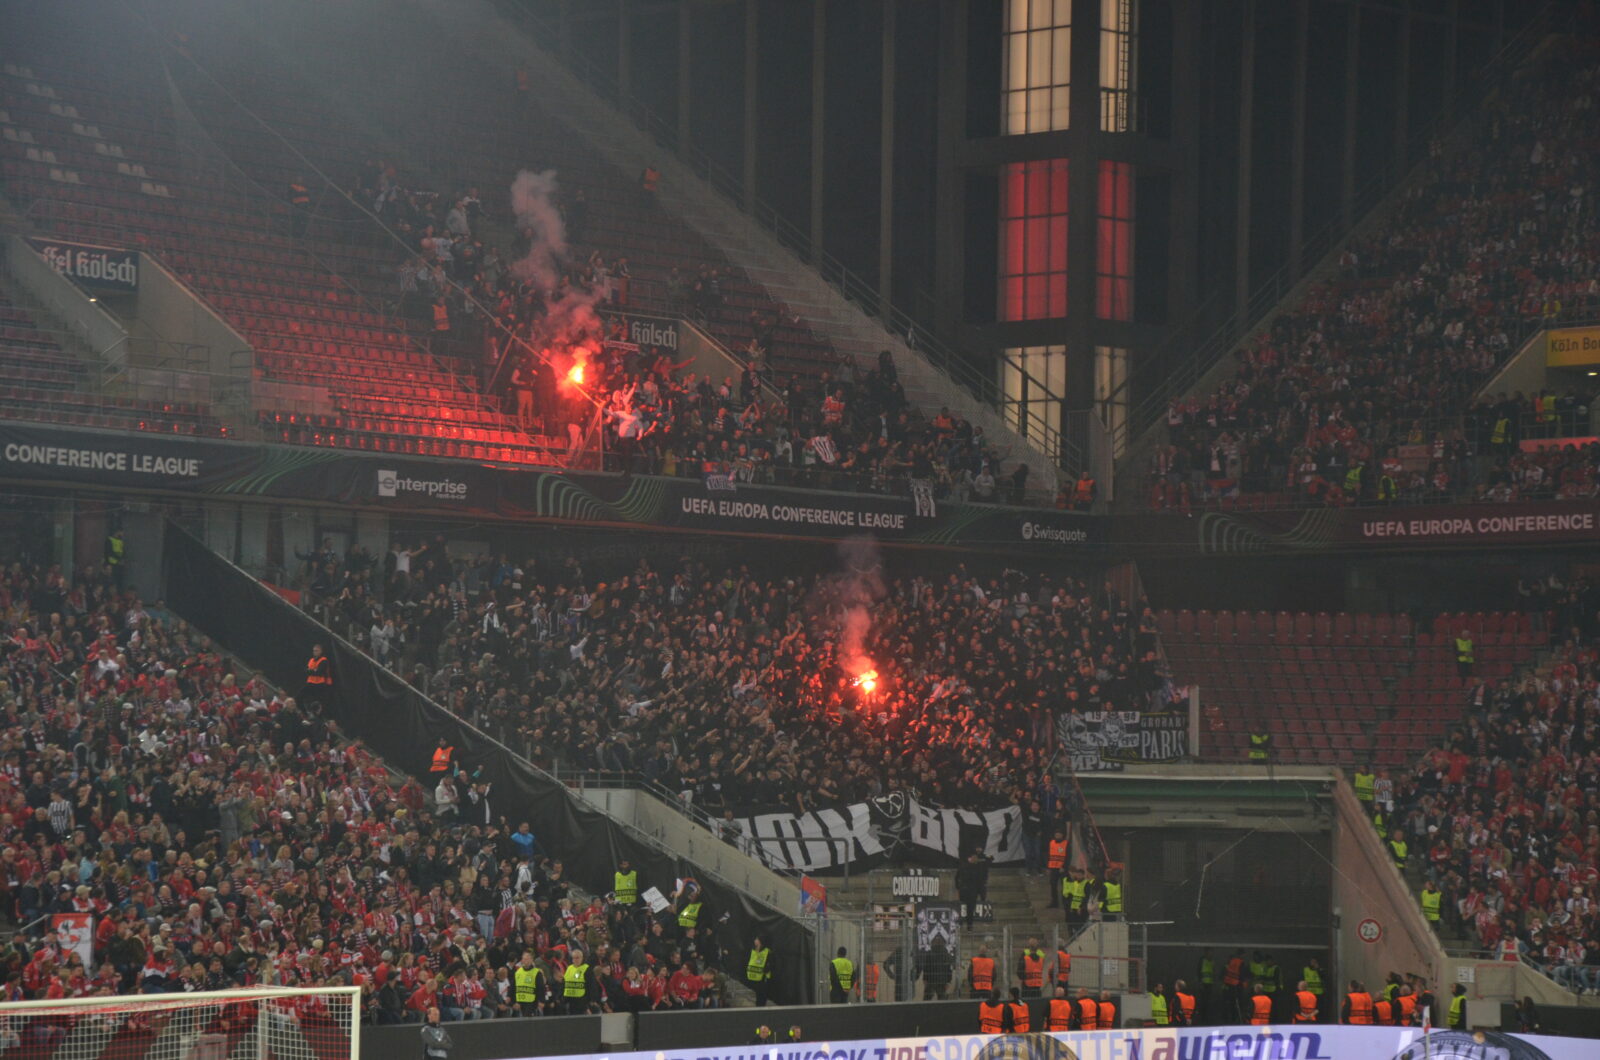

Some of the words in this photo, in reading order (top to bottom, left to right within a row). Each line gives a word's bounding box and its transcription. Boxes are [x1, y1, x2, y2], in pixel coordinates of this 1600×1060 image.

[1551, 338, 1579, 352] Köln
[1583, 337, 1600, 350] Bo
[5, 443, 127, 471] CONFERENCE
[132, 454, 199, 476] LEAGUE
[379, 472, 468, 496] enterprise
[682, 497, 717, 515] UEFA
[719, 501, 769, 520] EUROPA
[772, 505, 855, 526] CONFERENCE
[858, 512, 904, 529] LEAGUE
[1363, 521, 1407, 537] UEFA
[1409, 518, 1474, 536] EUROPA
[1477, 513, 1594, 533] CONFERENCE
[1033, 524, 1088, 543] Swissquote
[1140, 730, 1185, 760] PARIS
[892, 876, 940, 896] COMMANDO
